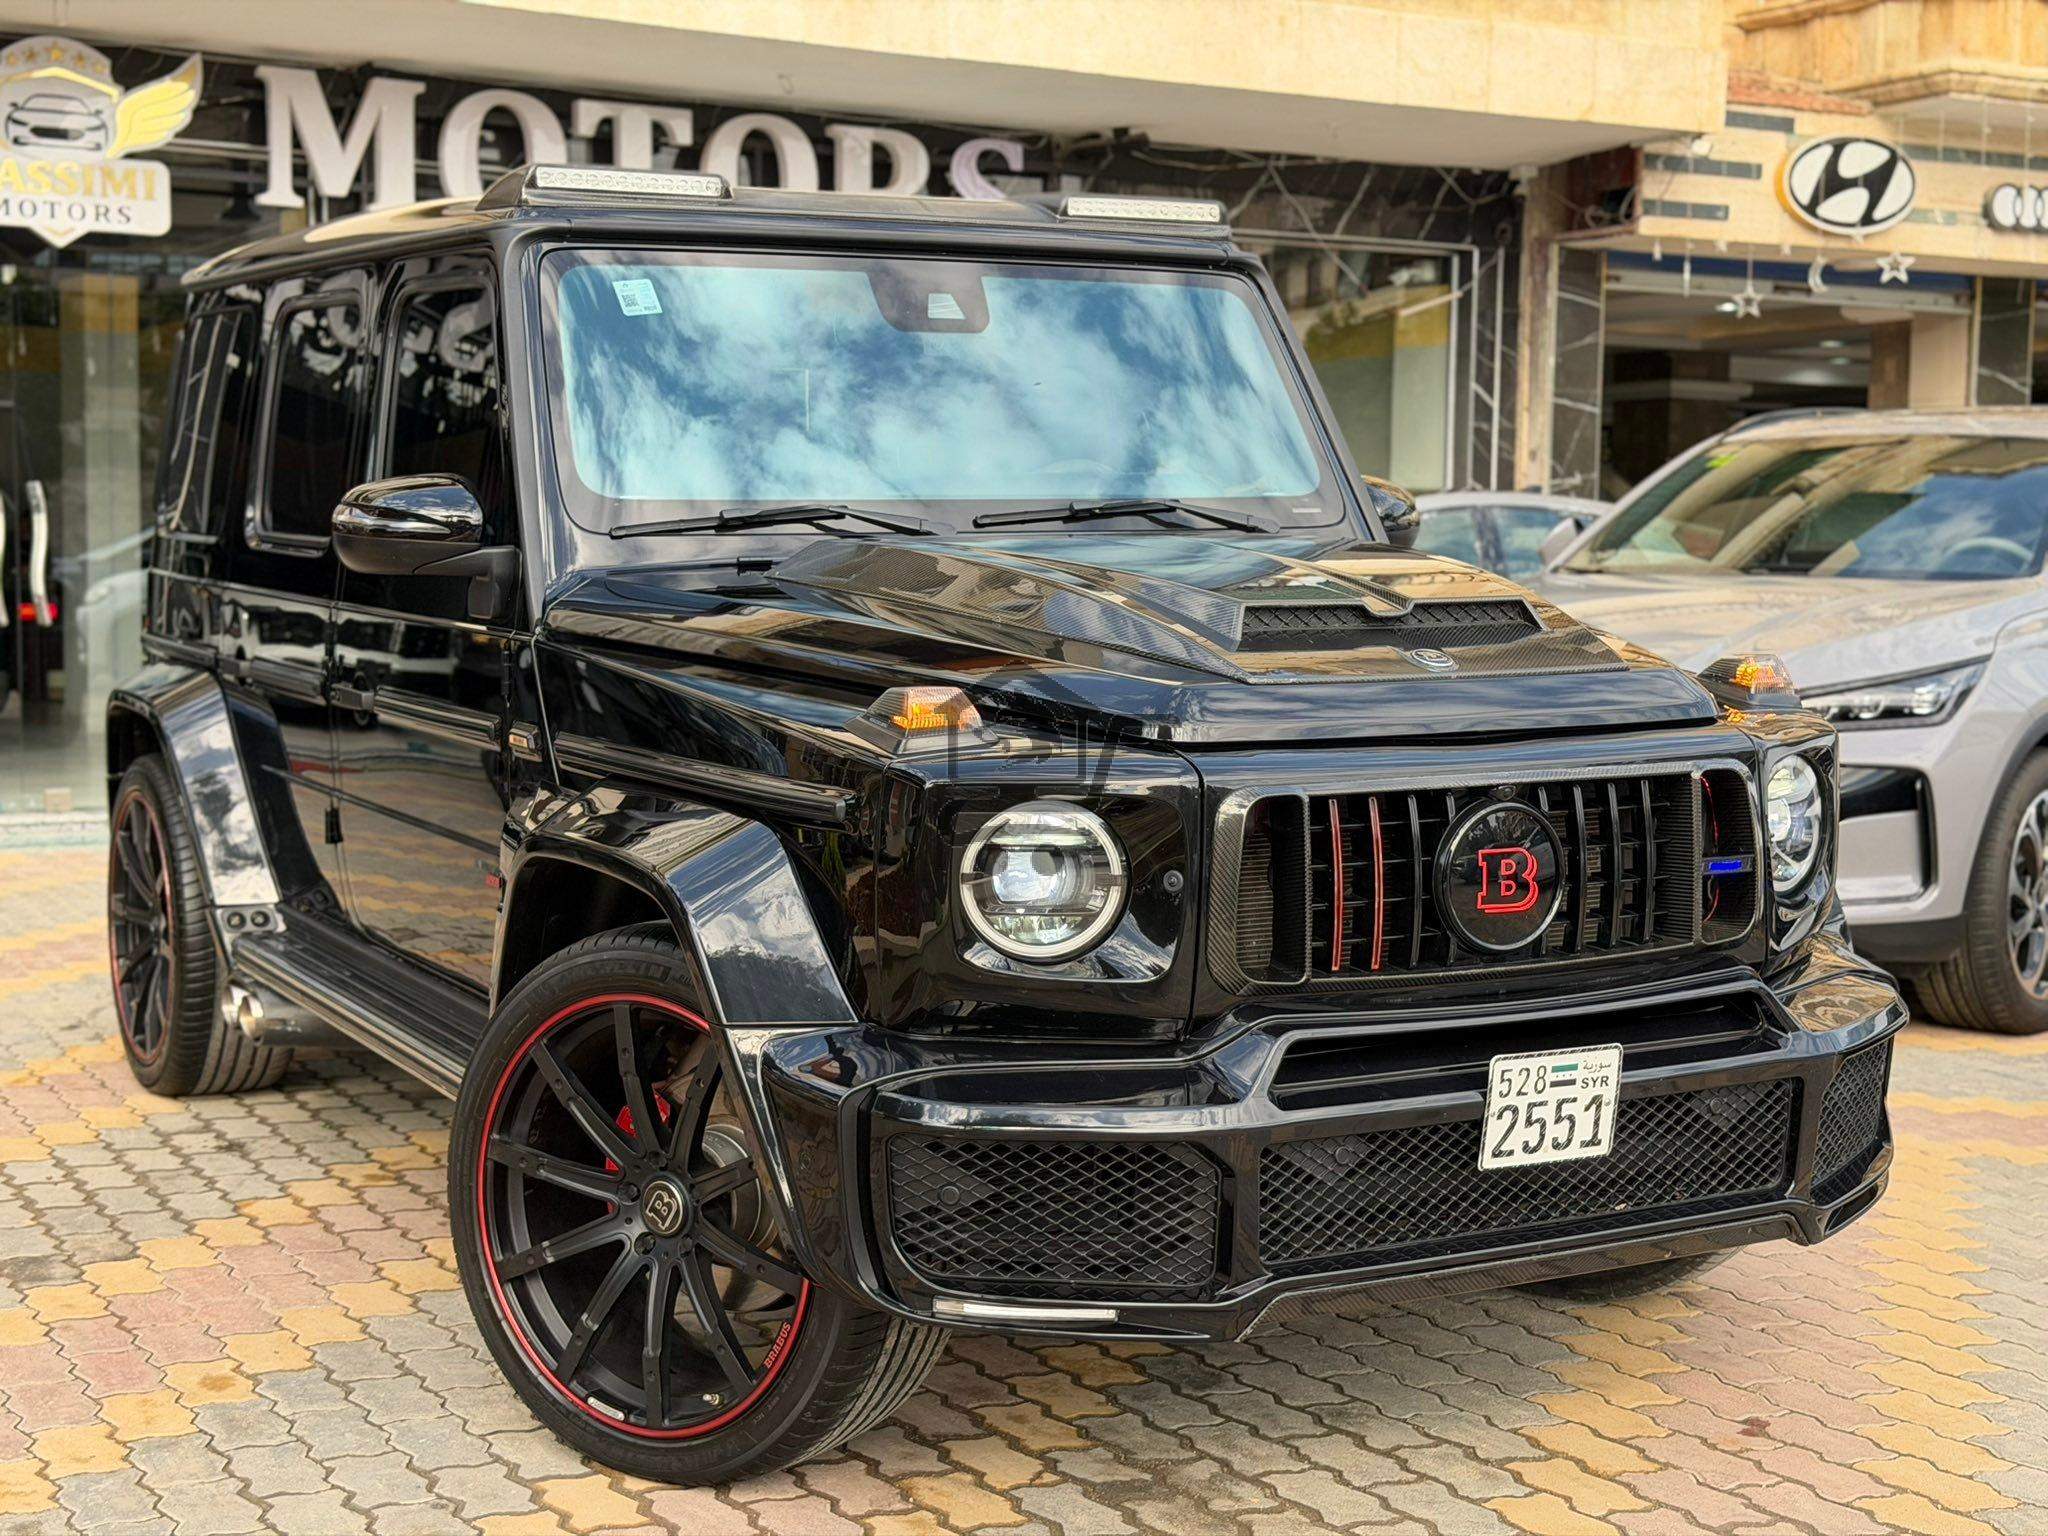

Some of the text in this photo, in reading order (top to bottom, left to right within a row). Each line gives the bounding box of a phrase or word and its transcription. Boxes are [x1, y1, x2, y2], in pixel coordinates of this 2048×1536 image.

[1477, 847, 1539, 914] B
[1499, 1065, 1547, 1098] 528
[1580, 1075, 1610, 1089] SYR
[1583, 1060, 1611, 1074] سورية
[1491, 1094, 1605, 1158] 2551
[763, 1322, 791, 1368] BRABUS
